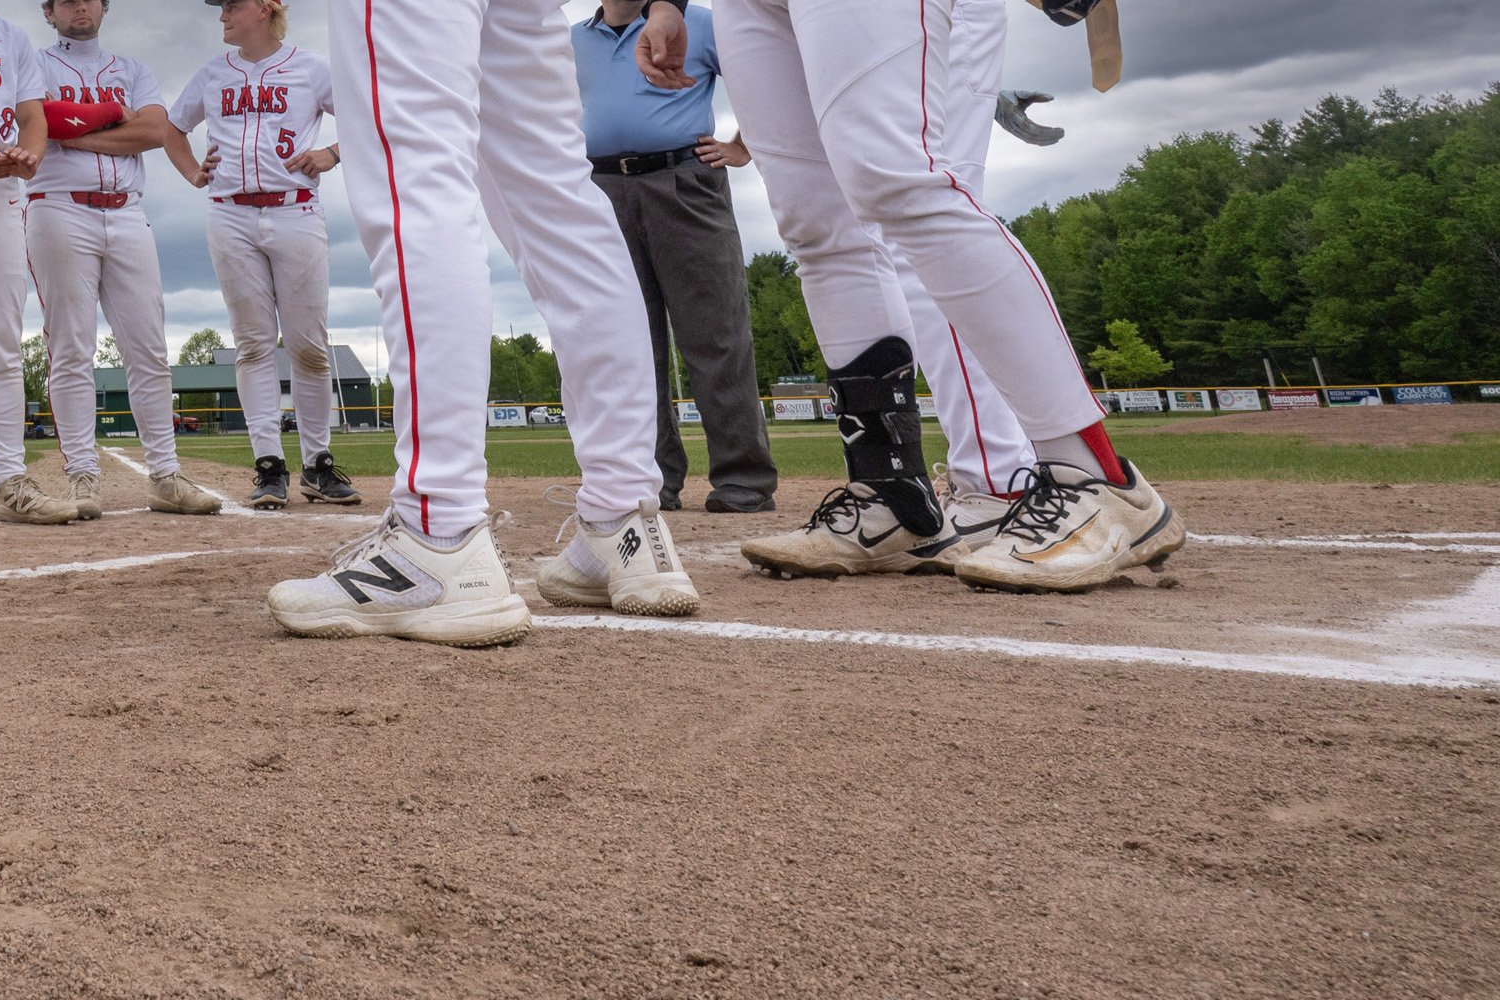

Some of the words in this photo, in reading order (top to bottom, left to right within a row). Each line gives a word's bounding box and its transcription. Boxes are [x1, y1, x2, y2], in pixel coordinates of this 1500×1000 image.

[221, 85, 288, 117] RAMS
[276, 127, 296, 160] 5
[1398, 386, 1443, 394] COLLEGE
[1268, 394, 1318, 402] Hammond
[1397, 392, 1448, 400] CARRY-OUT
[547, 407, 562, 415] 330
[332, 554, 417, 605] N
